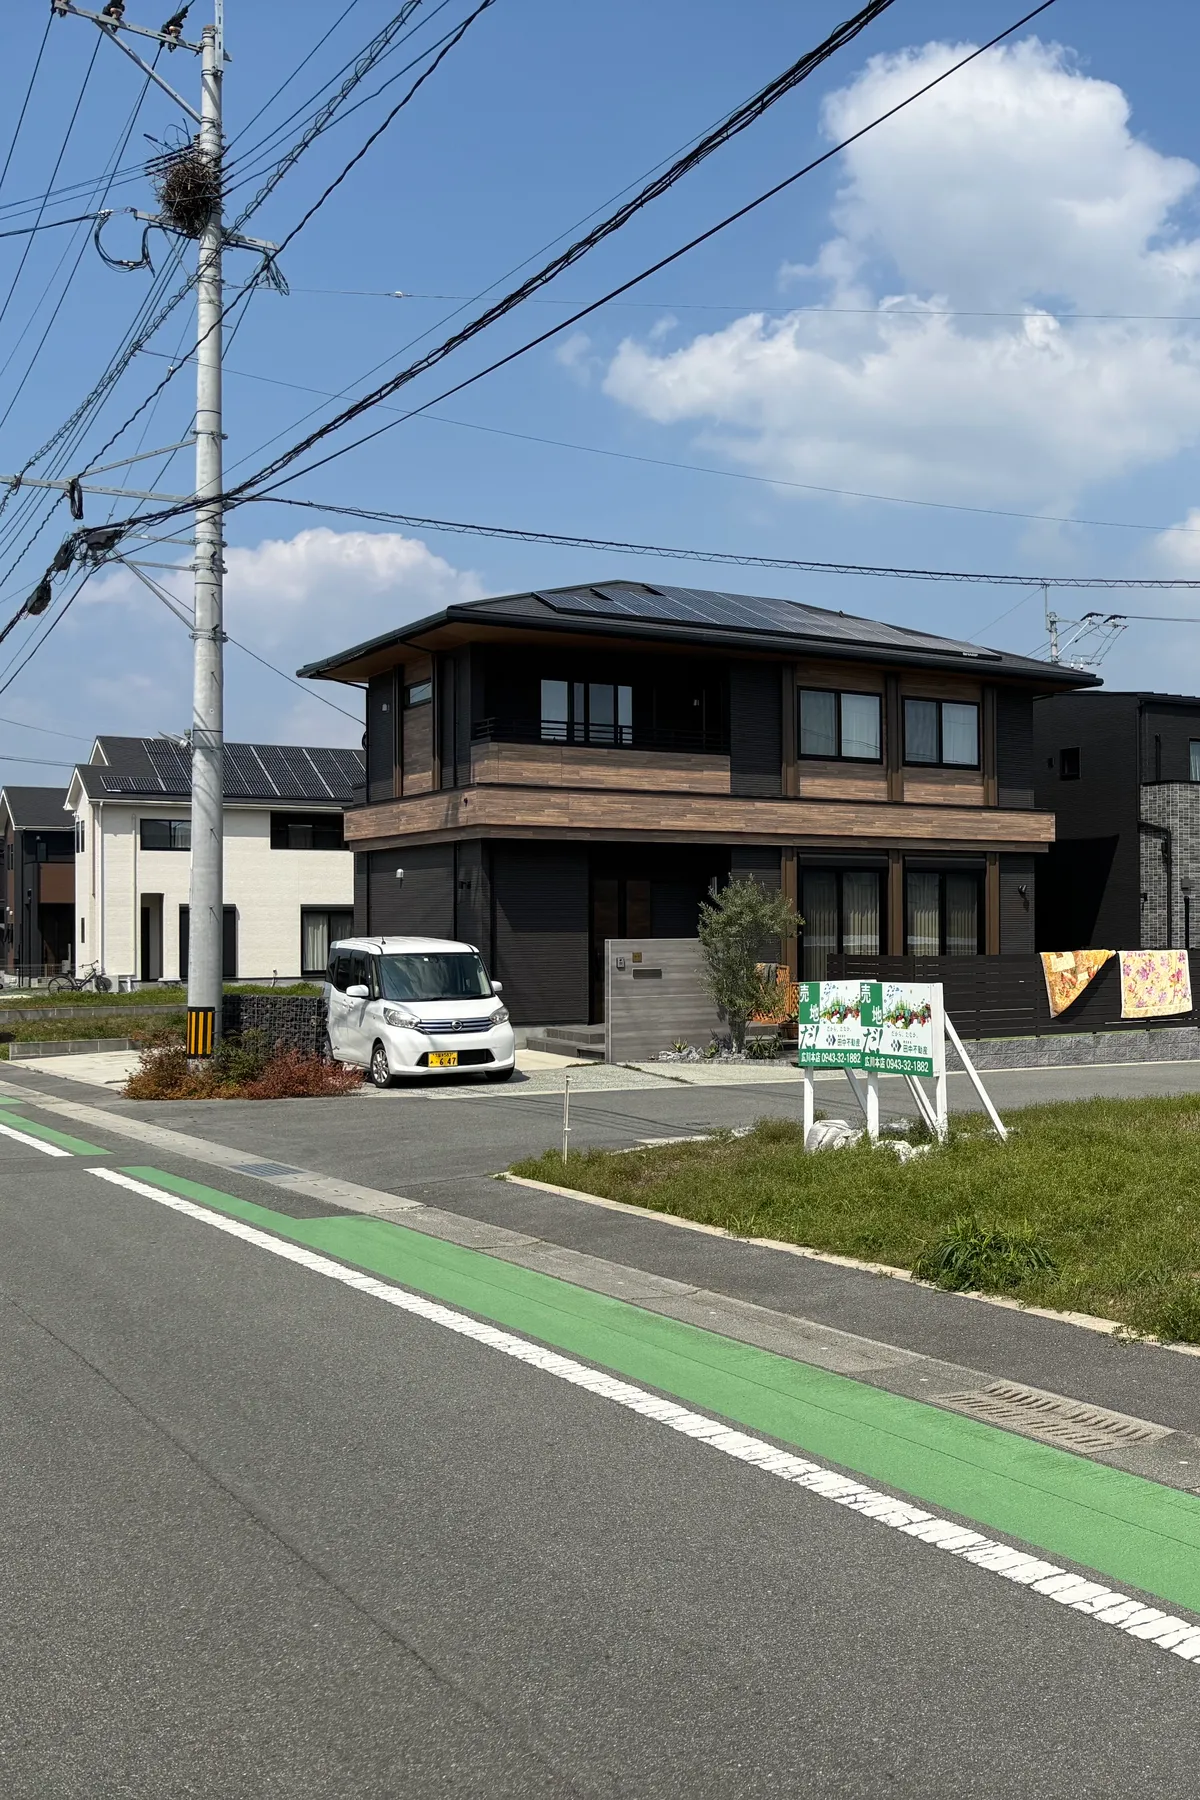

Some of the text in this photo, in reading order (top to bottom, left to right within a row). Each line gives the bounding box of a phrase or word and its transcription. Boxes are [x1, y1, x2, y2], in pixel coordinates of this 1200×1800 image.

[800, 984, 819, 1022] 売地
[861, 984, 883, 1025] 売地
[838, 1038, 860, 1047] 田中不動産
[903, 1044, 928, 1055] 田中不動産
[801, 1052, 861, 1064] 広川本店 0943-32-1882
[864, 1056, 929, 1073] 広川本店 0943-32-1882
